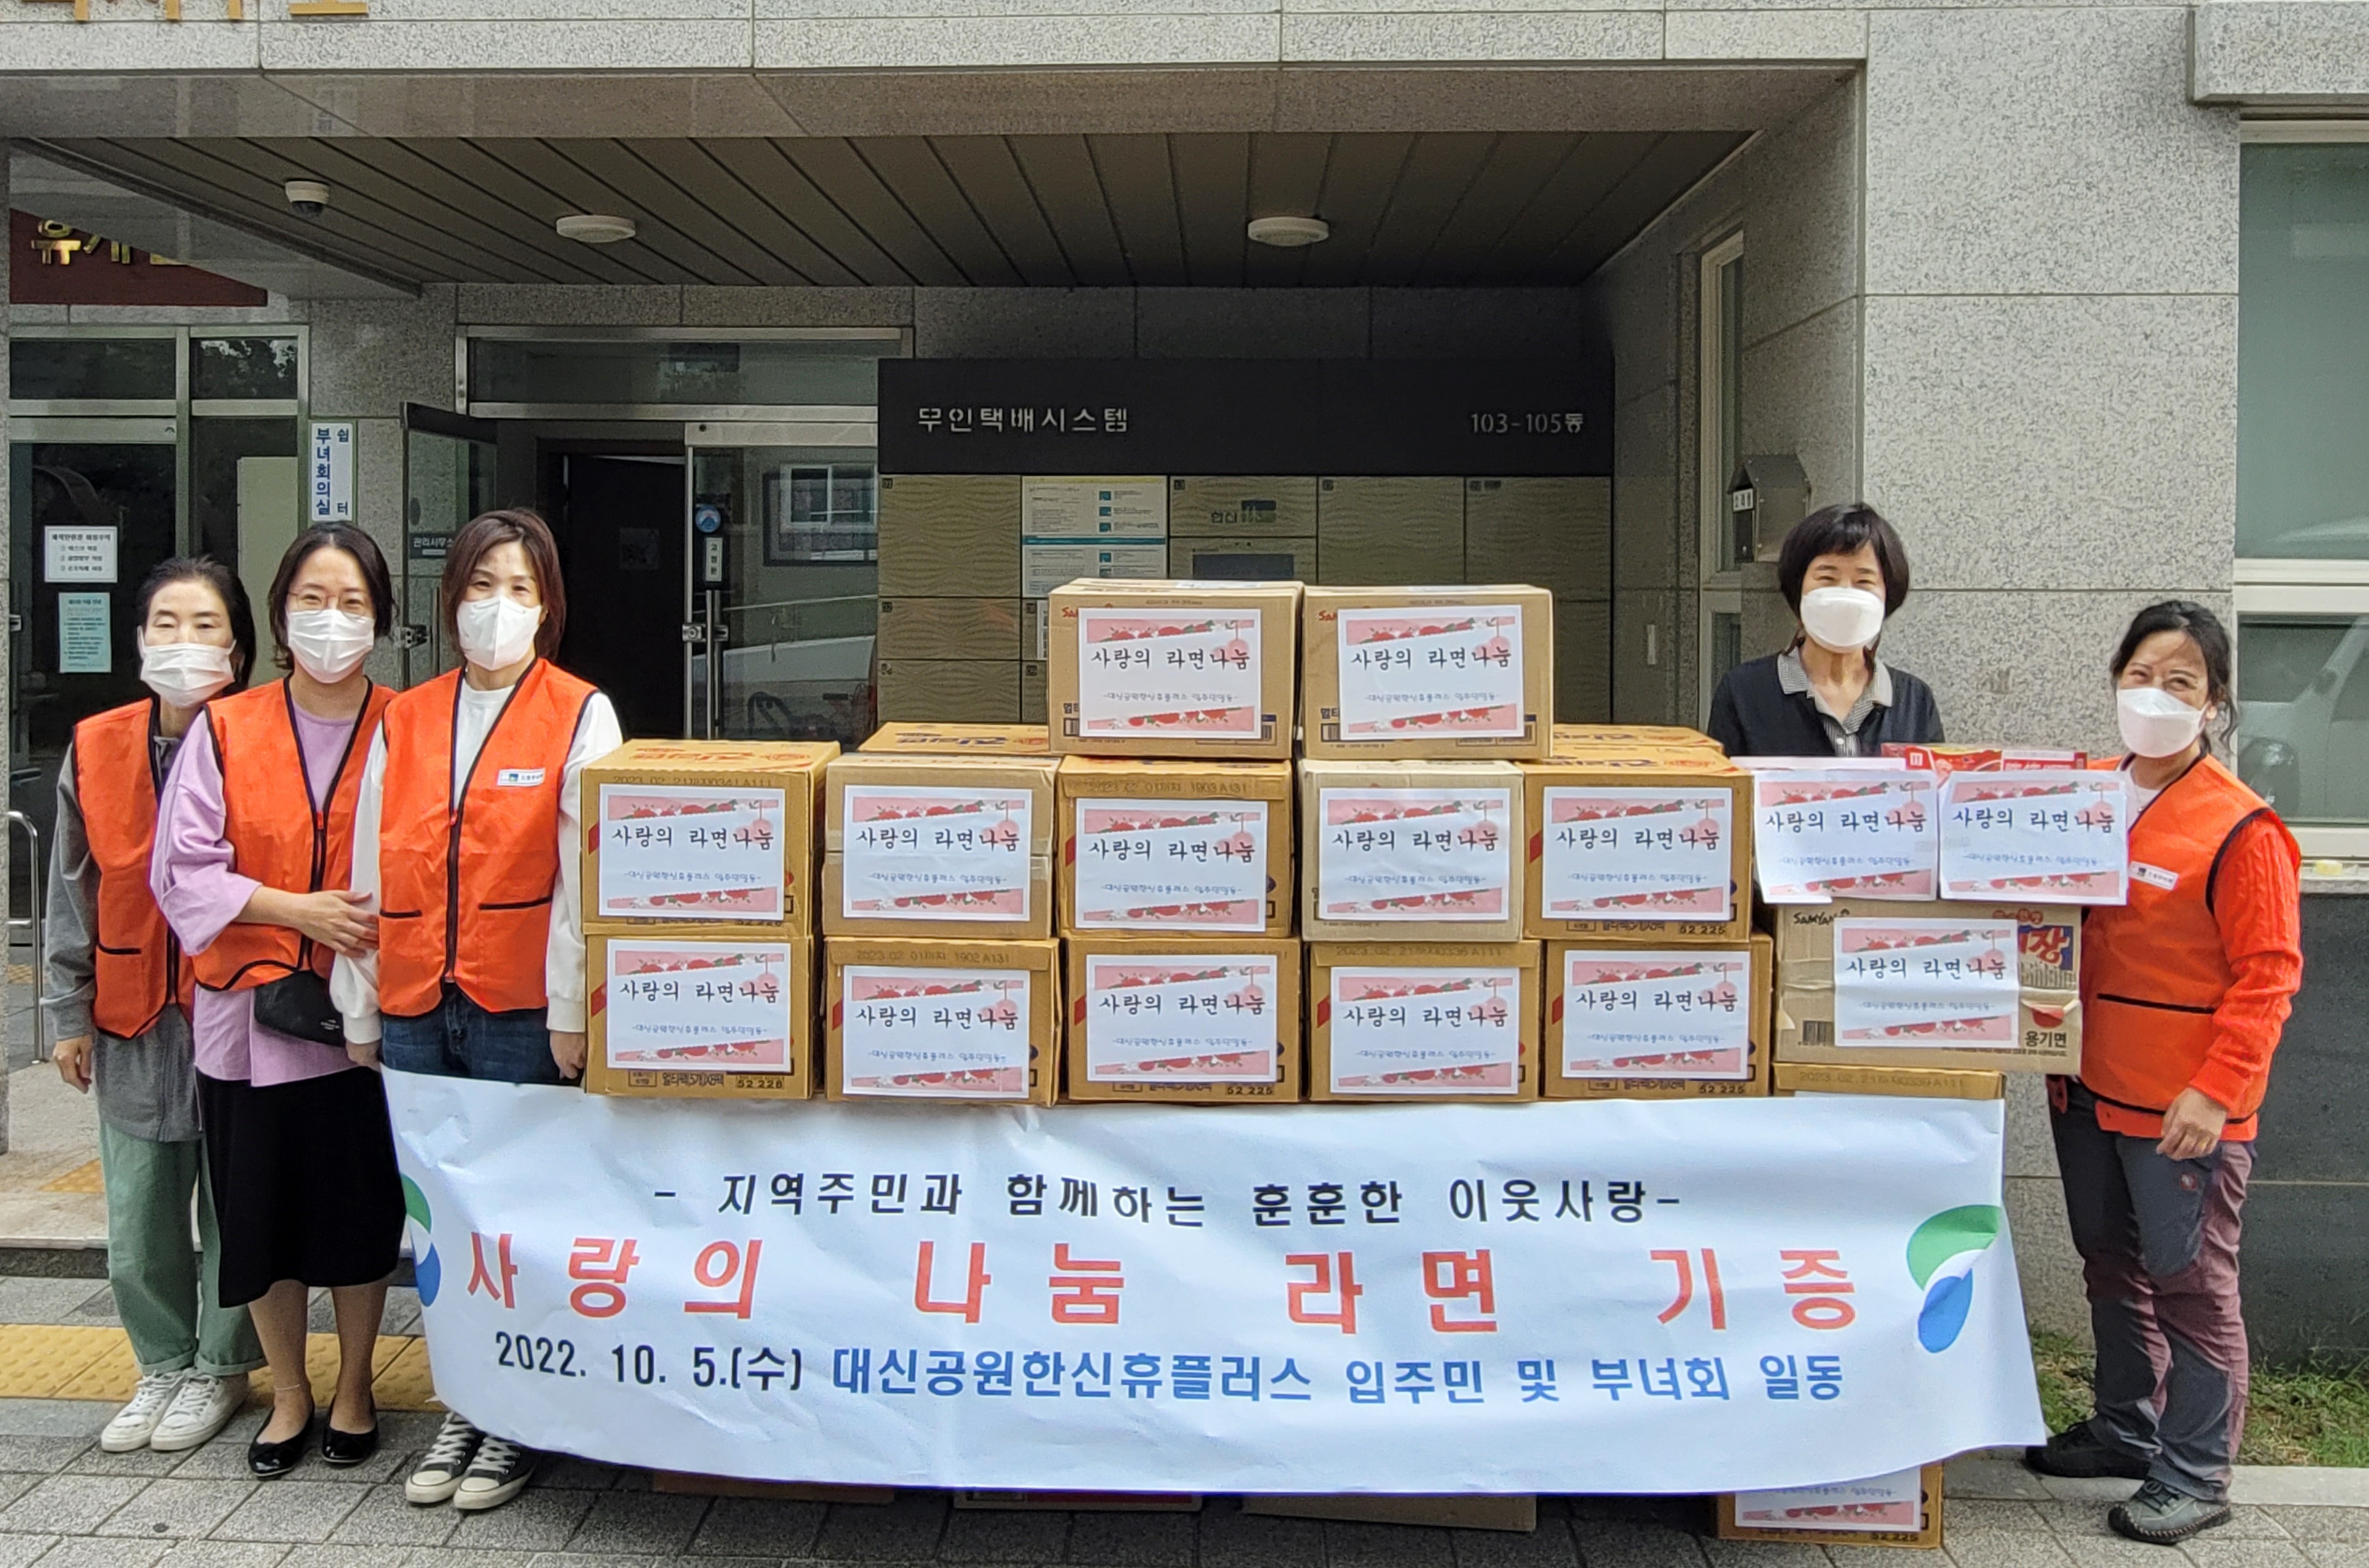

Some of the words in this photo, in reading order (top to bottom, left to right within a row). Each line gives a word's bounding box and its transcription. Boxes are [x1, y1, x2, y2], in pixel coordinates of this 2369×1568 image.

[918, 408, 1128, 433] 무인택배시스템
[1471, 413, 1583, 433] 103-105동
[316, 428, 331, 516] 부녀회의실
[1092, 648, 1150, 669] 사랑의
[1352, 648, 1410, 671] 사랑의
[1769, 811, 1823, 833] 사랑의
[1953, 808, 2012, 829] 사랑의
[612, 825, 672, 848] 사랑의
[858, 827, 917, 849] 사랑의
[1334, 830, 1394, 851] 사랑의
[1557, 828, 1617, 849] 사랑의
[1090, 839, 1150, 861] 사랑의
[1848, 958, 1905, 980] 사랑의
[620, 980, 678, 1002] 사랑의
[1576, 990, 1637, 1011] 사랑의
[1099, 994, 1161, 1015] 사랑의
[856, 1006, 916, 1027] 사랑의
[1344, 1006, 1405, 1027] 사랑의
[2025, 1031, 2067, 1048] 용기면
[719, 1174, 962, 1215] 지역주민과
[1008, 1175, 1204, 1226] 함께하는
[1253, 1181, 1401, 1226] 훈훈한
[469, 1232, 761, 1319] 사랑의
[914, 1242, 1125, 1324] 나눔
[1285, 1251, 1497, 1334] 라면
[1650, 1249, 1856, 1330] 기증
[496, 1332, 586, 1377] 2022.
[612, 1345, 665, 1384] 10.
[834, 1349, 1311, 1401] 대신공원한신휴플러스
[1347, 1360, 1484, 1403] 입주민
[1517, 1359, 1559, 1402] 및
[1591, 1357, 1730, 1401] 부녀회
[1760, 1355, 1843, 1400] 일동
